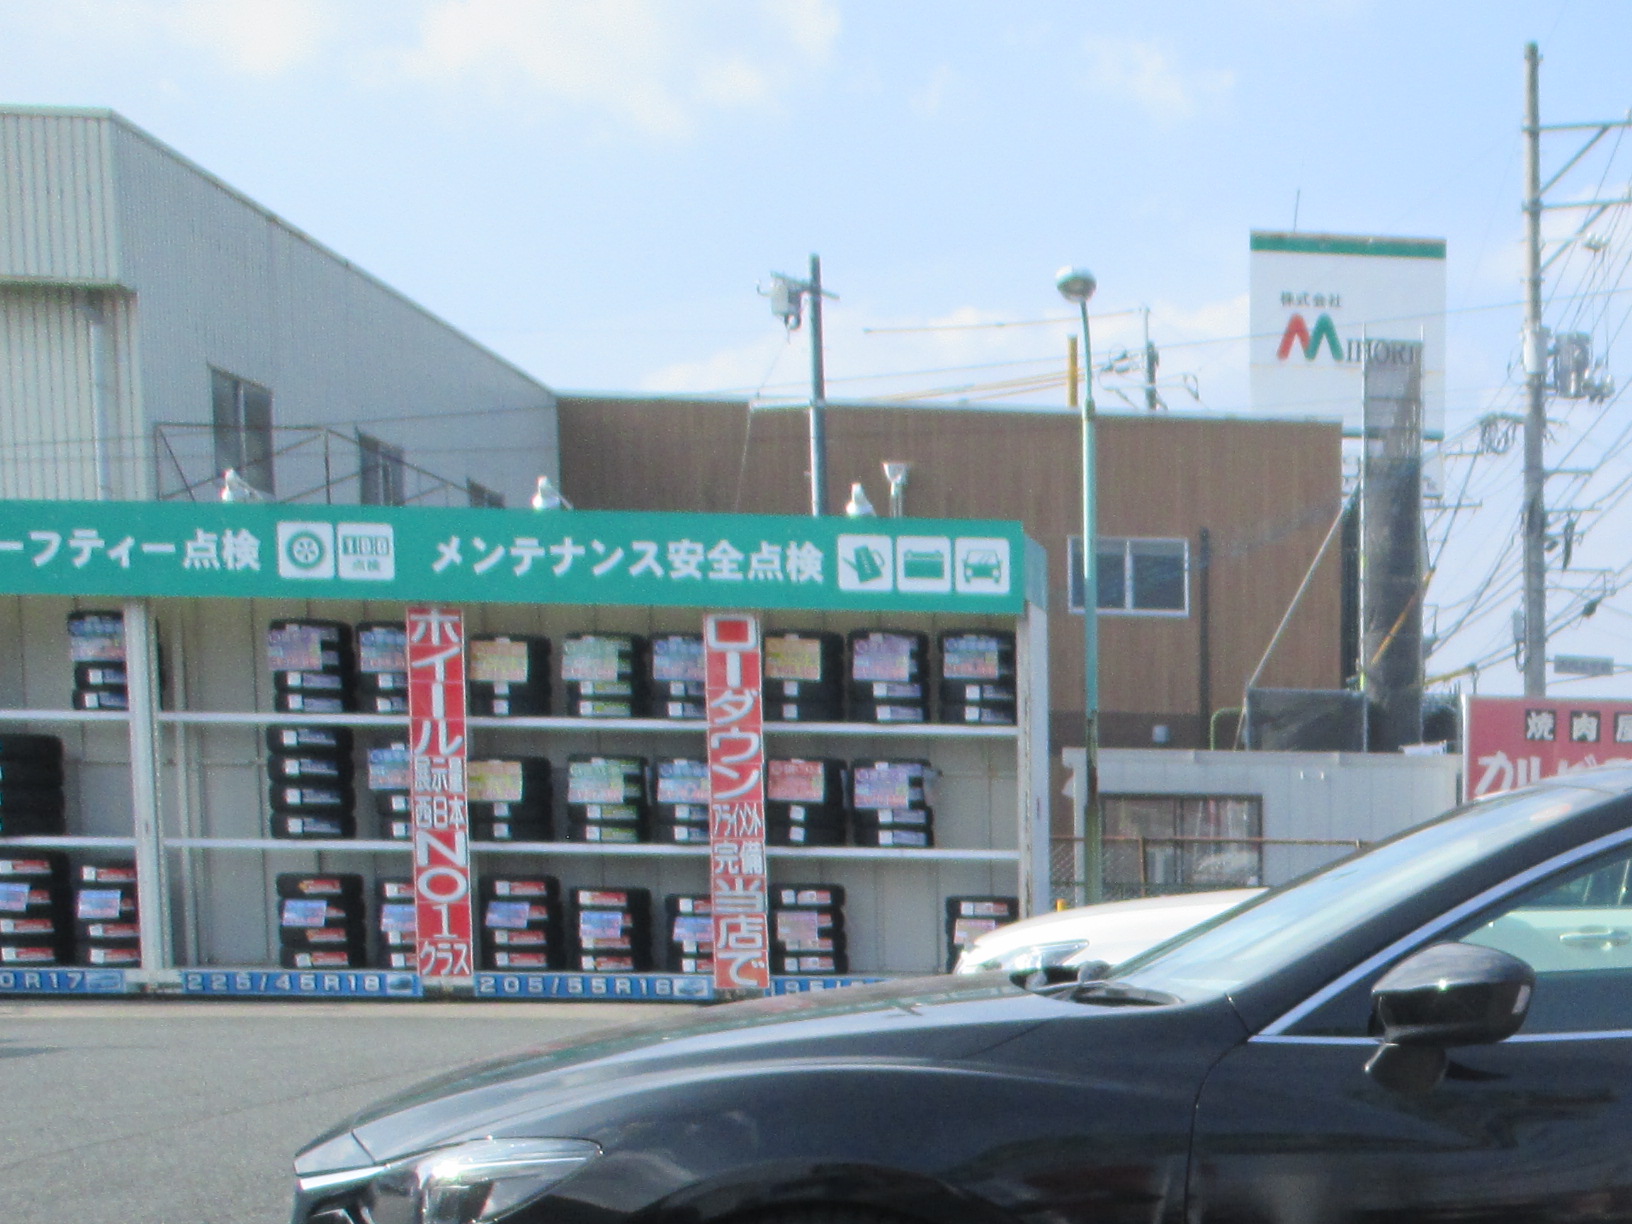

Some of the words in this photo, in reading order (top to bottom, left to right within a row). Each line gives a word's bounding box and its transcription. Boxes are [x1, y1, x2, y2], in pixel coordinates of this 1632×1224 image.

[431, 535, 824, 584] メンテナンス安全点検
